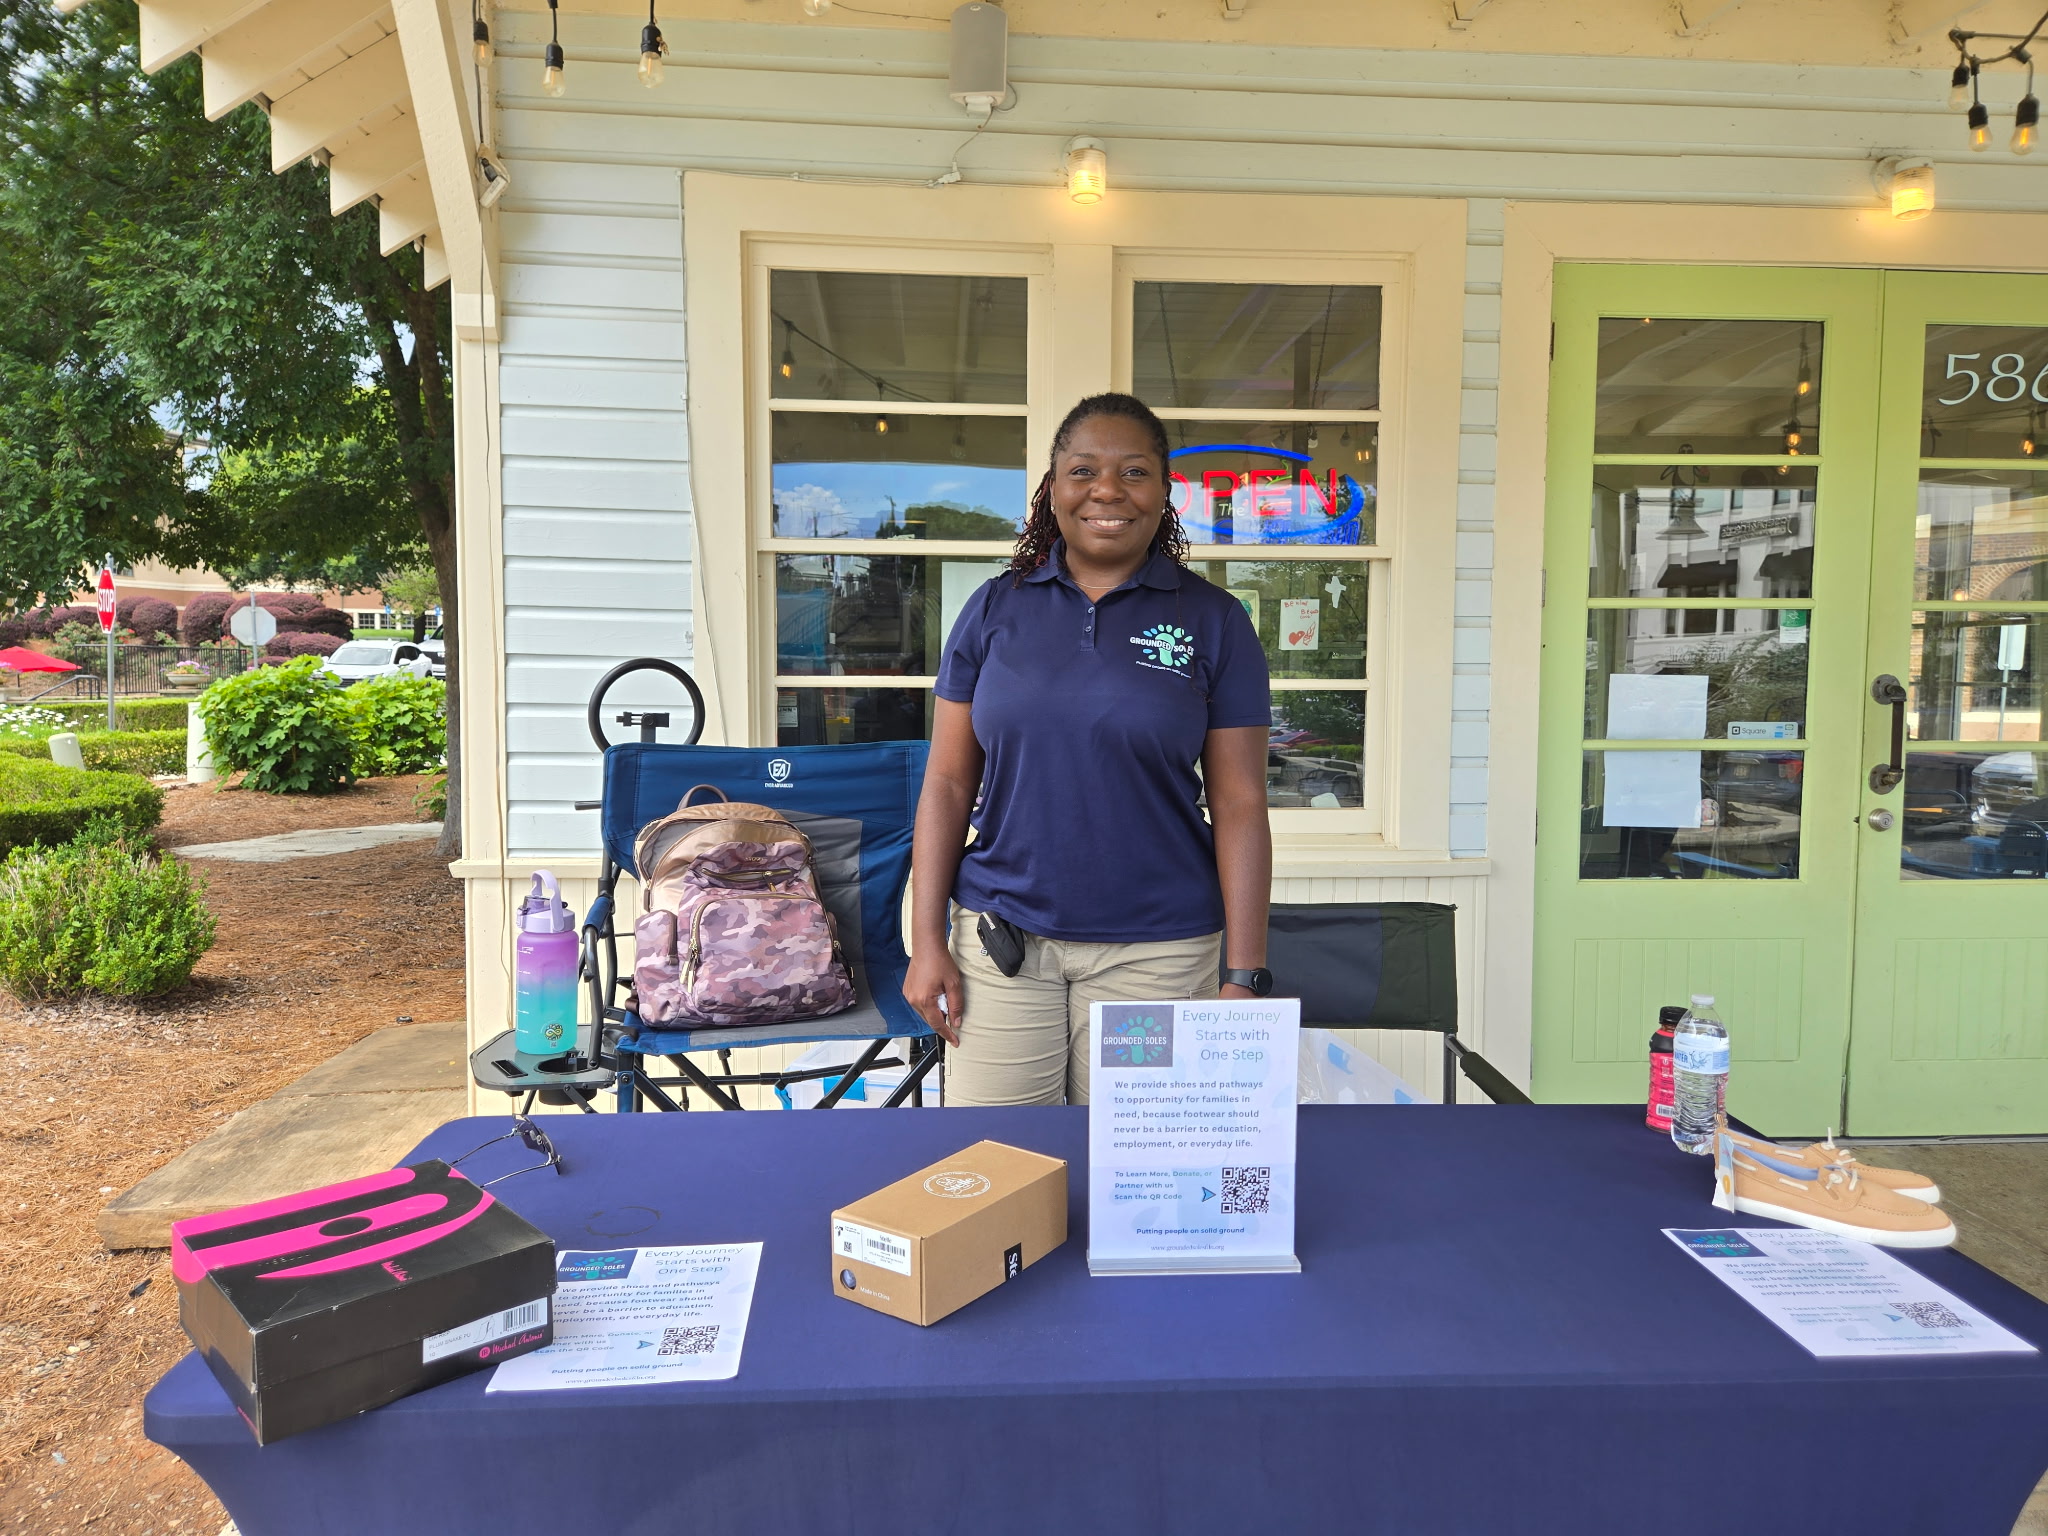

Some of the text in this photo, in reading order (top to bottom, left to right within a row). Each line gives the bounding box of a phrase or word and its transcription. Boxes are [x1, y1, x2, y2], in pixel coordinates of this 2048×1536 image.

[1219, 503, 1245, 516] The
[99, 589, 114, 612] STOP
[1130, 636, 1171, 650] GROUNDED
[1182, 1010, 1280, 1024] Every Journey
[1195, 1029, 1269, 1041] Starts with
[1103, 1037, 1167, 1045] GROUNDED SOLES
[1201, 1049, 1263, 1062] One Step
[1132, 1081, 1167, 1090] provide
[1219, 1081, 1263, 1089] pathways
[1127, 1096, 1183, 1104] opportunity
[1202, 1095, 1239, 1103] families
[1242, 1095, 1250, 1103] in
[1114, 1111, 1140, 1119] need,
[1184, 1110, 1225, 1118] footwear
[1228, 1110, 1259, 1118] should
[1212, 1125, 1261, 1133] education,
[1114, 1140, 1175, 1149] employment,
[1190, 1140, 1233, 1149] everyday
[687, 1248, 743, 1256] Journey
[860, 1287, 872, 1295] Made
[878, 1292, 890, 1301] China
